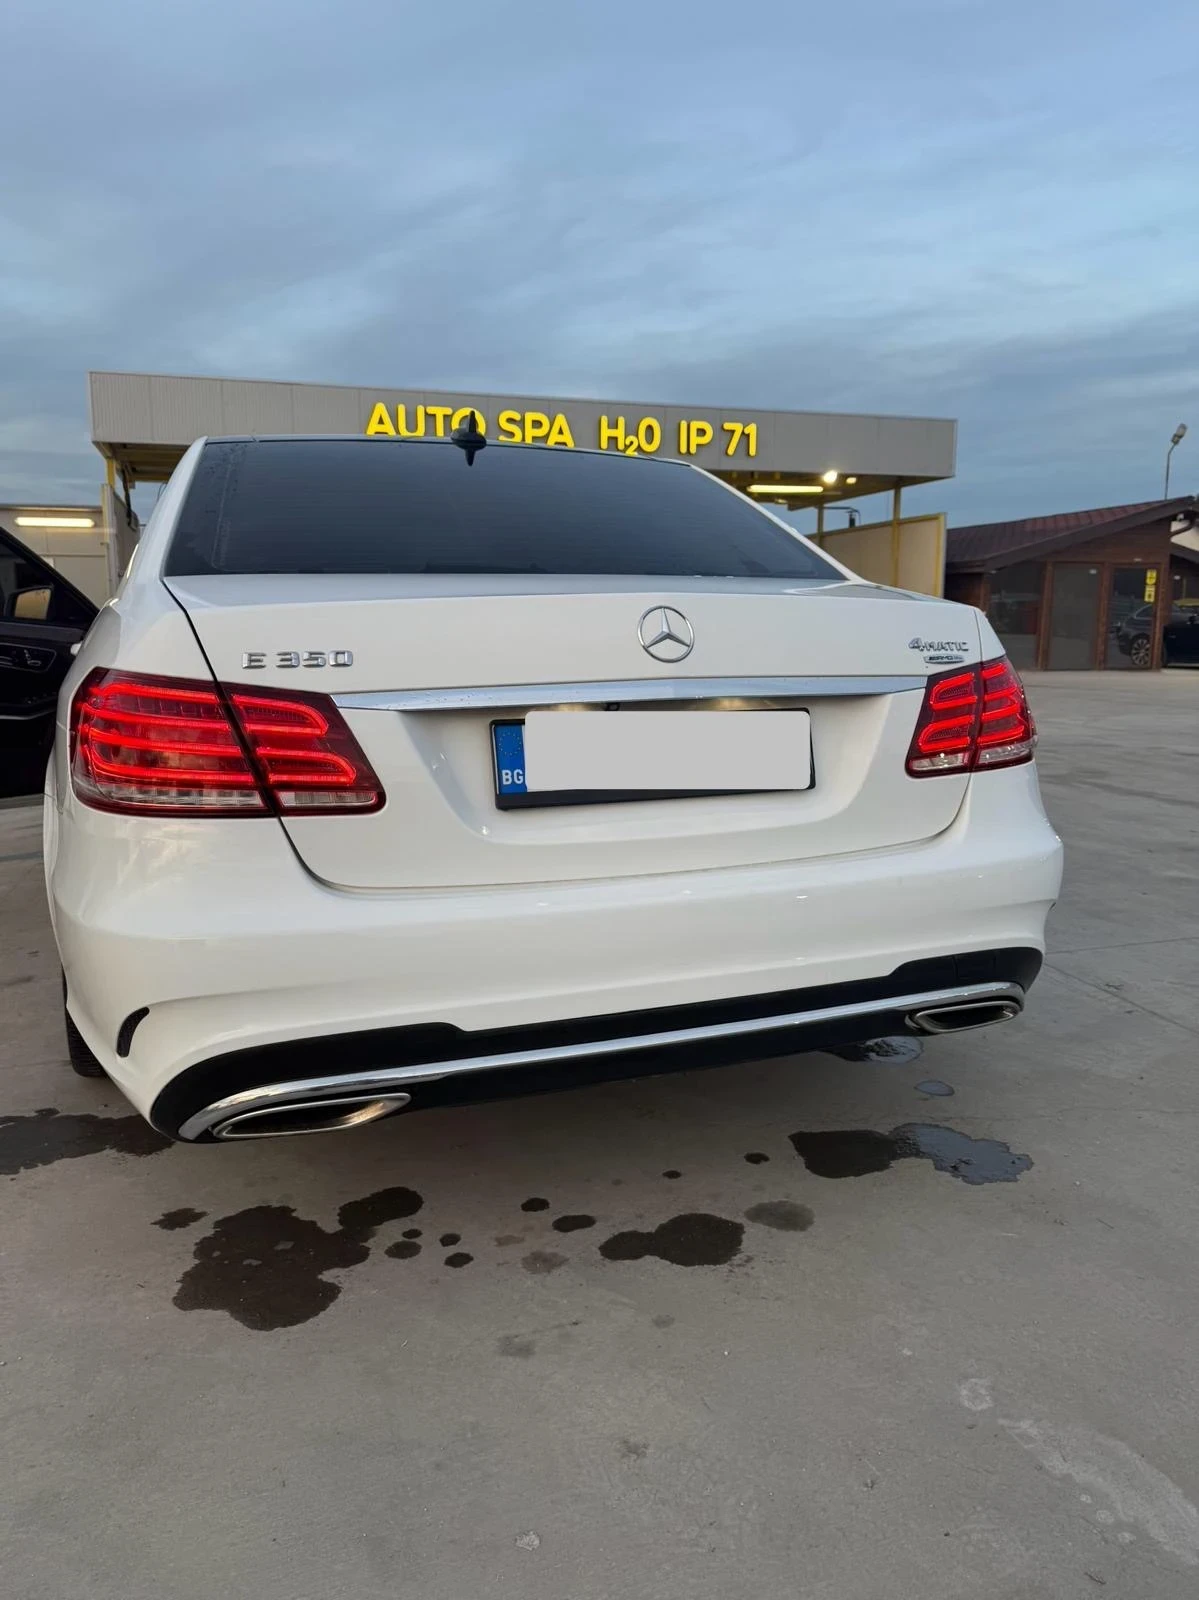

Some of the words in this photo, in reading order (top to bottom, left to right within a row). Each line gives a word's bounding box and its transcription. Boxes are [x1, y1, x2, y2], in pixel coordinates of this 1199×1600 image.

[367, 403, 486, 437] AUTO
[499, 410, 574, 449] SPA
[680, 421, 713, 454] IP
[723, 423, 757, 457] 71
[908, 637, 969, 652] 4MATIC
[242, 652, 266, 669] E
[276, 650, 353, 668] 350
[502, 769, 524, 785] BG
